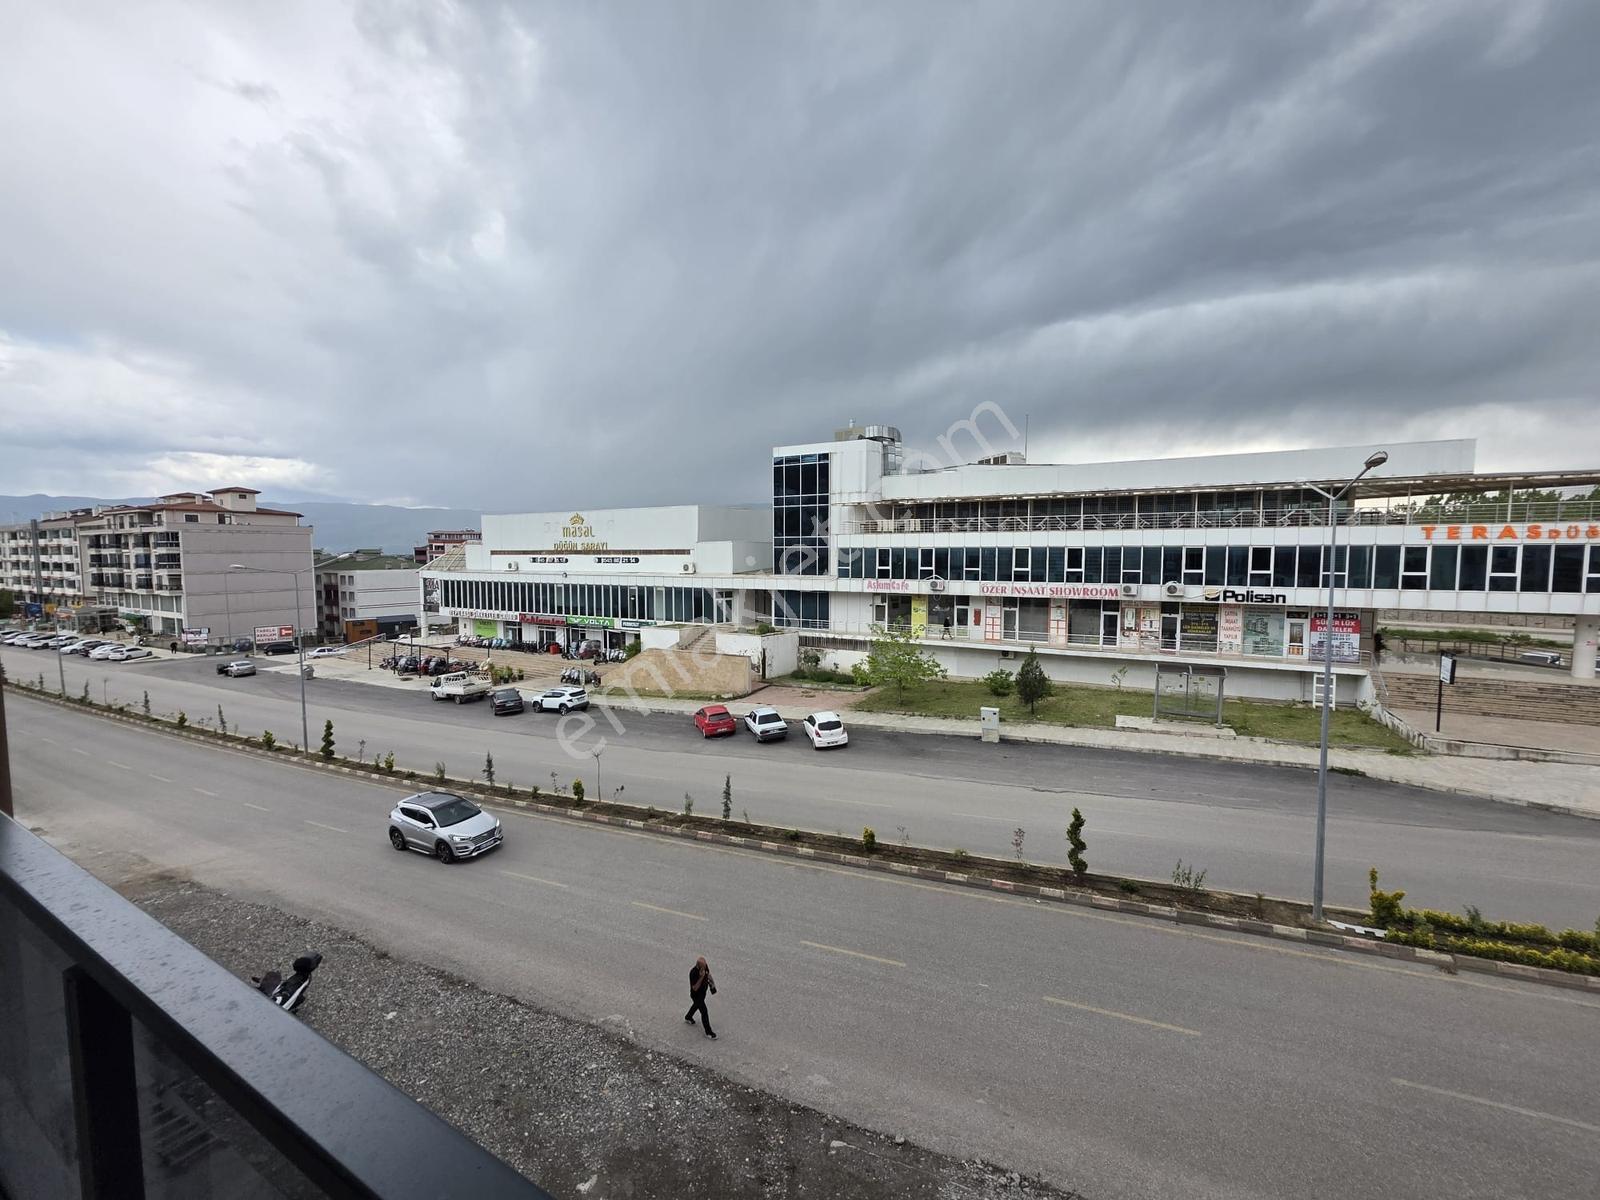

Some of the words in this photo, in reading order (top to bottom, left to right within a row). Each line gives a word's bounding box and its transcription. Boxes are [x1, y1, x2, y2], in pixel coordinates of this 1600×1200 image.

[1422, 524, 1542, 540] TERAS
[981, 583, 1007, 594] ÖZER
[1049, 587, 1119, 597] SHOWROOM
[1223, 590, 1286, 603] Polisan
[584, 618, 610, 626] VOLTA
